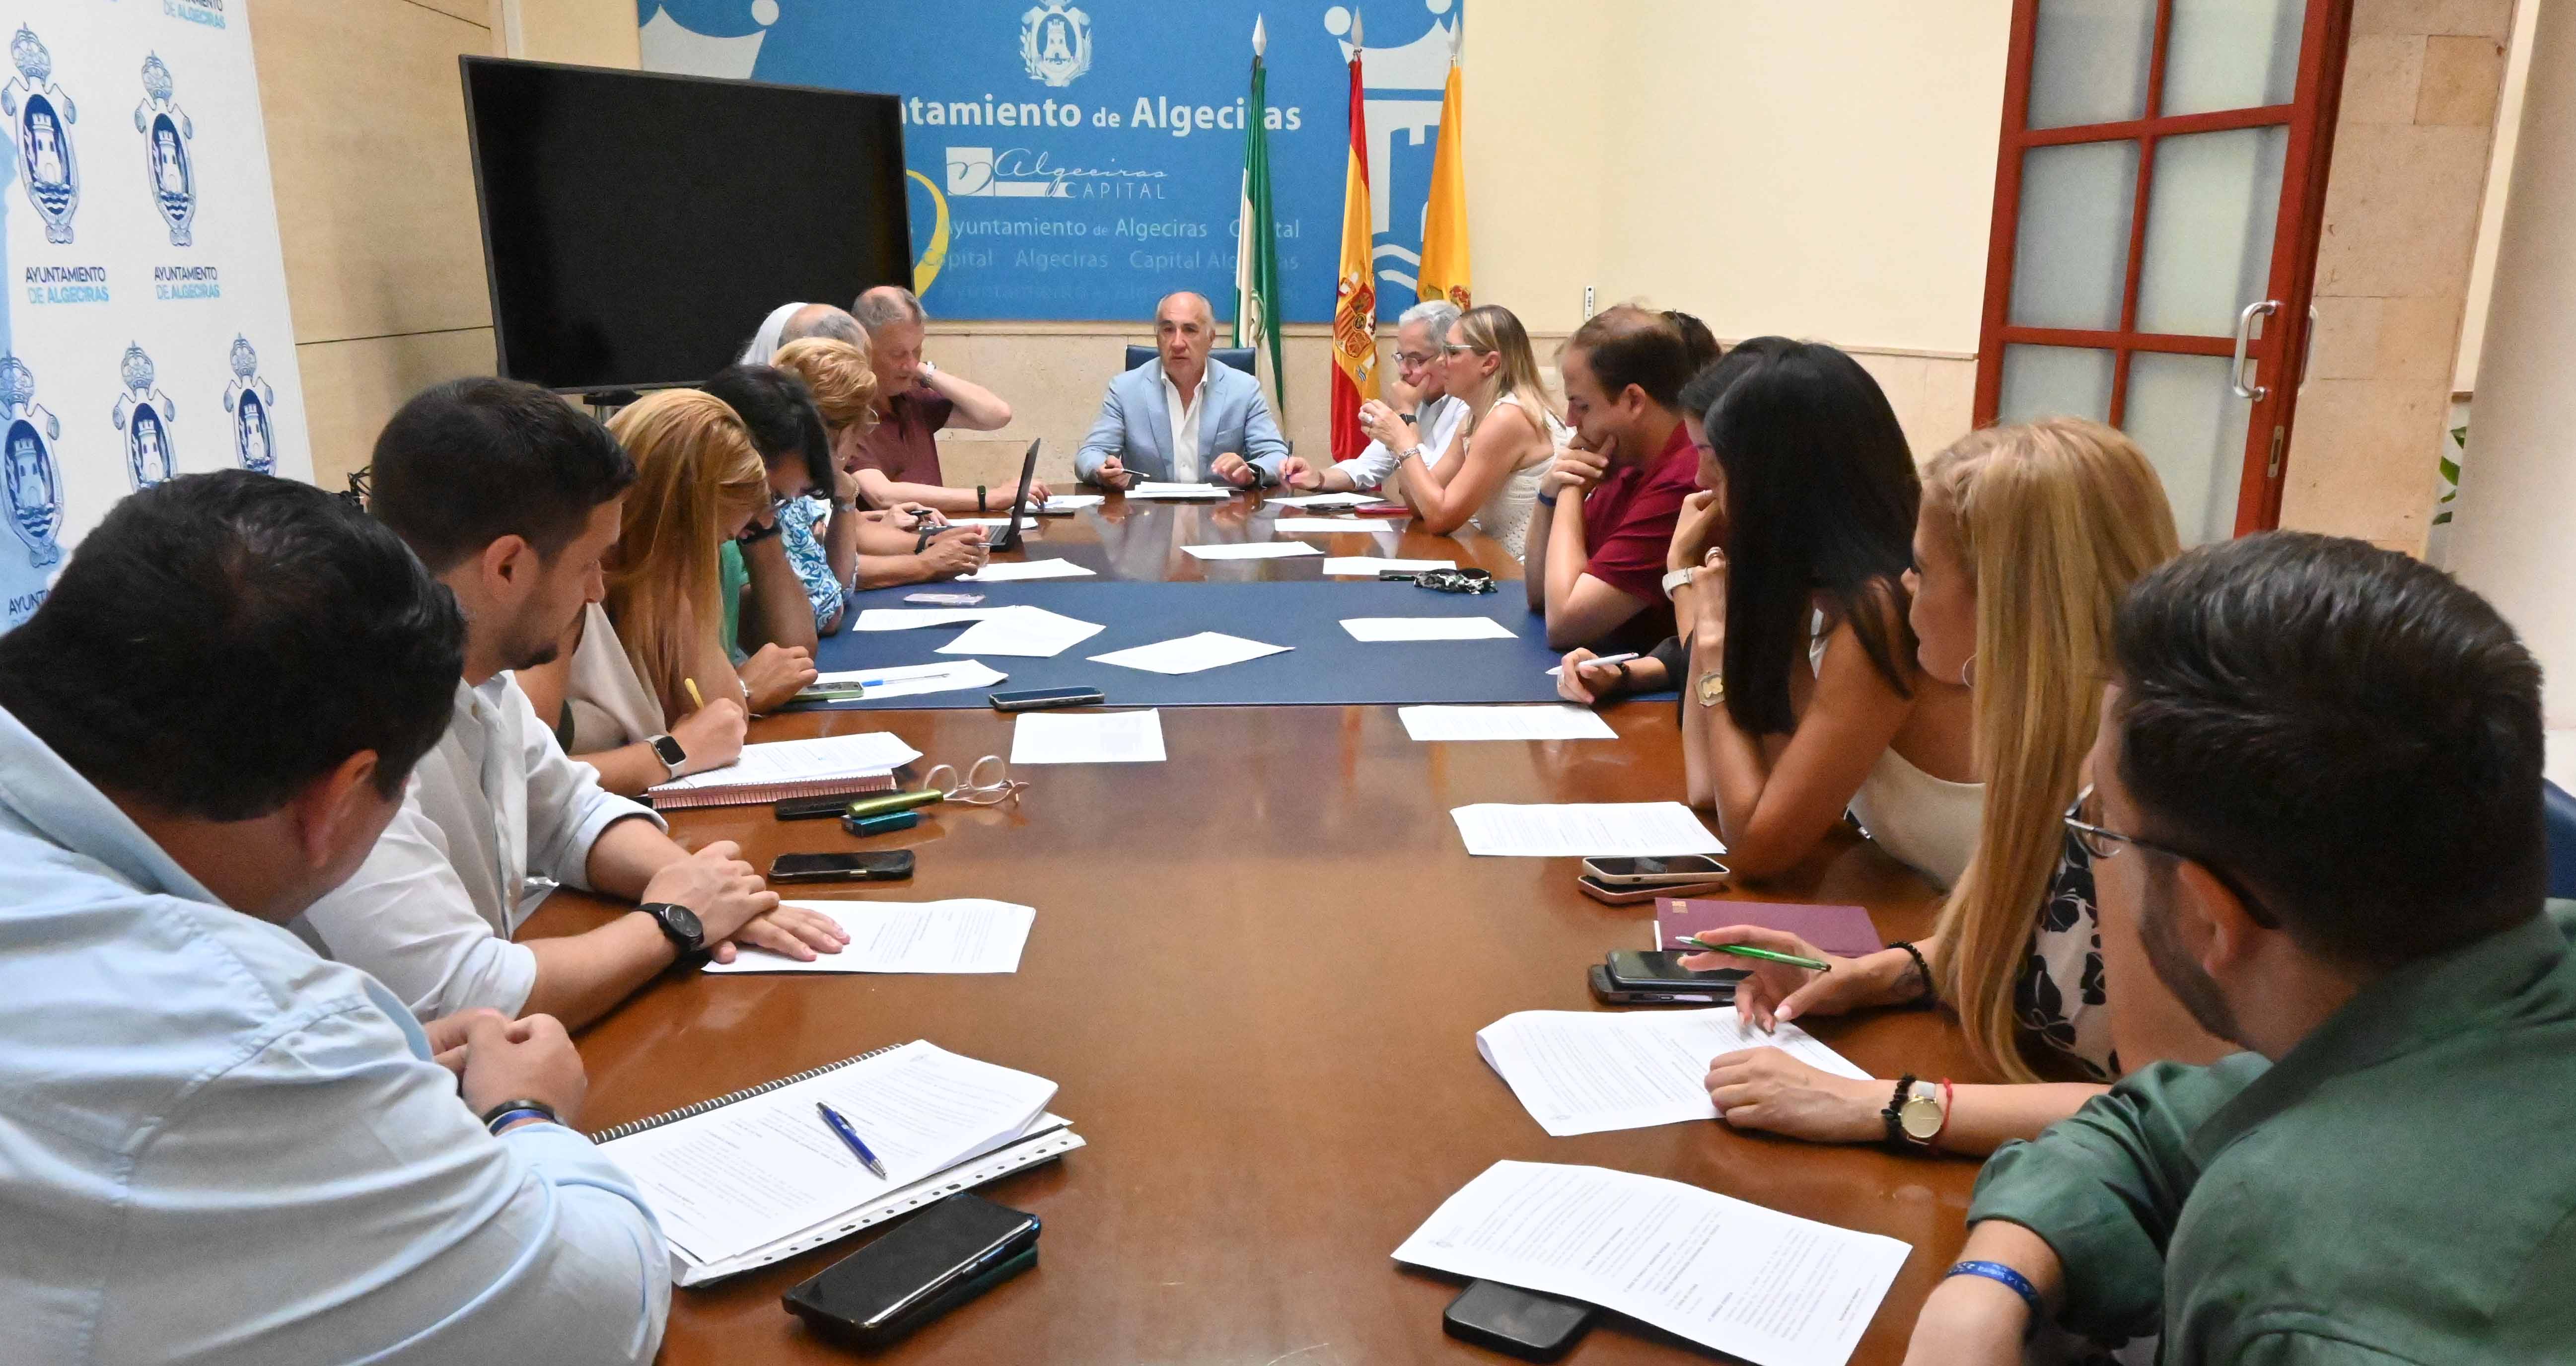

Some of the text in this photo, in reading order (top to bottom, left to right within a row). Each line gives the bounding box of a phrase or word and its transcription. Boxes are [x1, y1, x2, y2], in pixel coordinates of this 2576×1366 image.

[901, 93, 1301, 137] tamiento de Algecias
[995, 148, 1168, 198] Algeciras
[1065, 182, 1166, 200] CAPITAL
[948, 217, 1299, 241] yuntamiento de Algeciras Ctal
[1015, 249, 1108, 271] Algeciras
[1130, 250, 1200, 272] Capital
[26, 267, 106, 283] AYUNTAMIENTO
[154, 267, 217, 282] AYUNTAMIENTO
[27, 287, 109, 304] DE ALGECIRAS
[156, 284, 220, 299] DE ALGECIRAS
